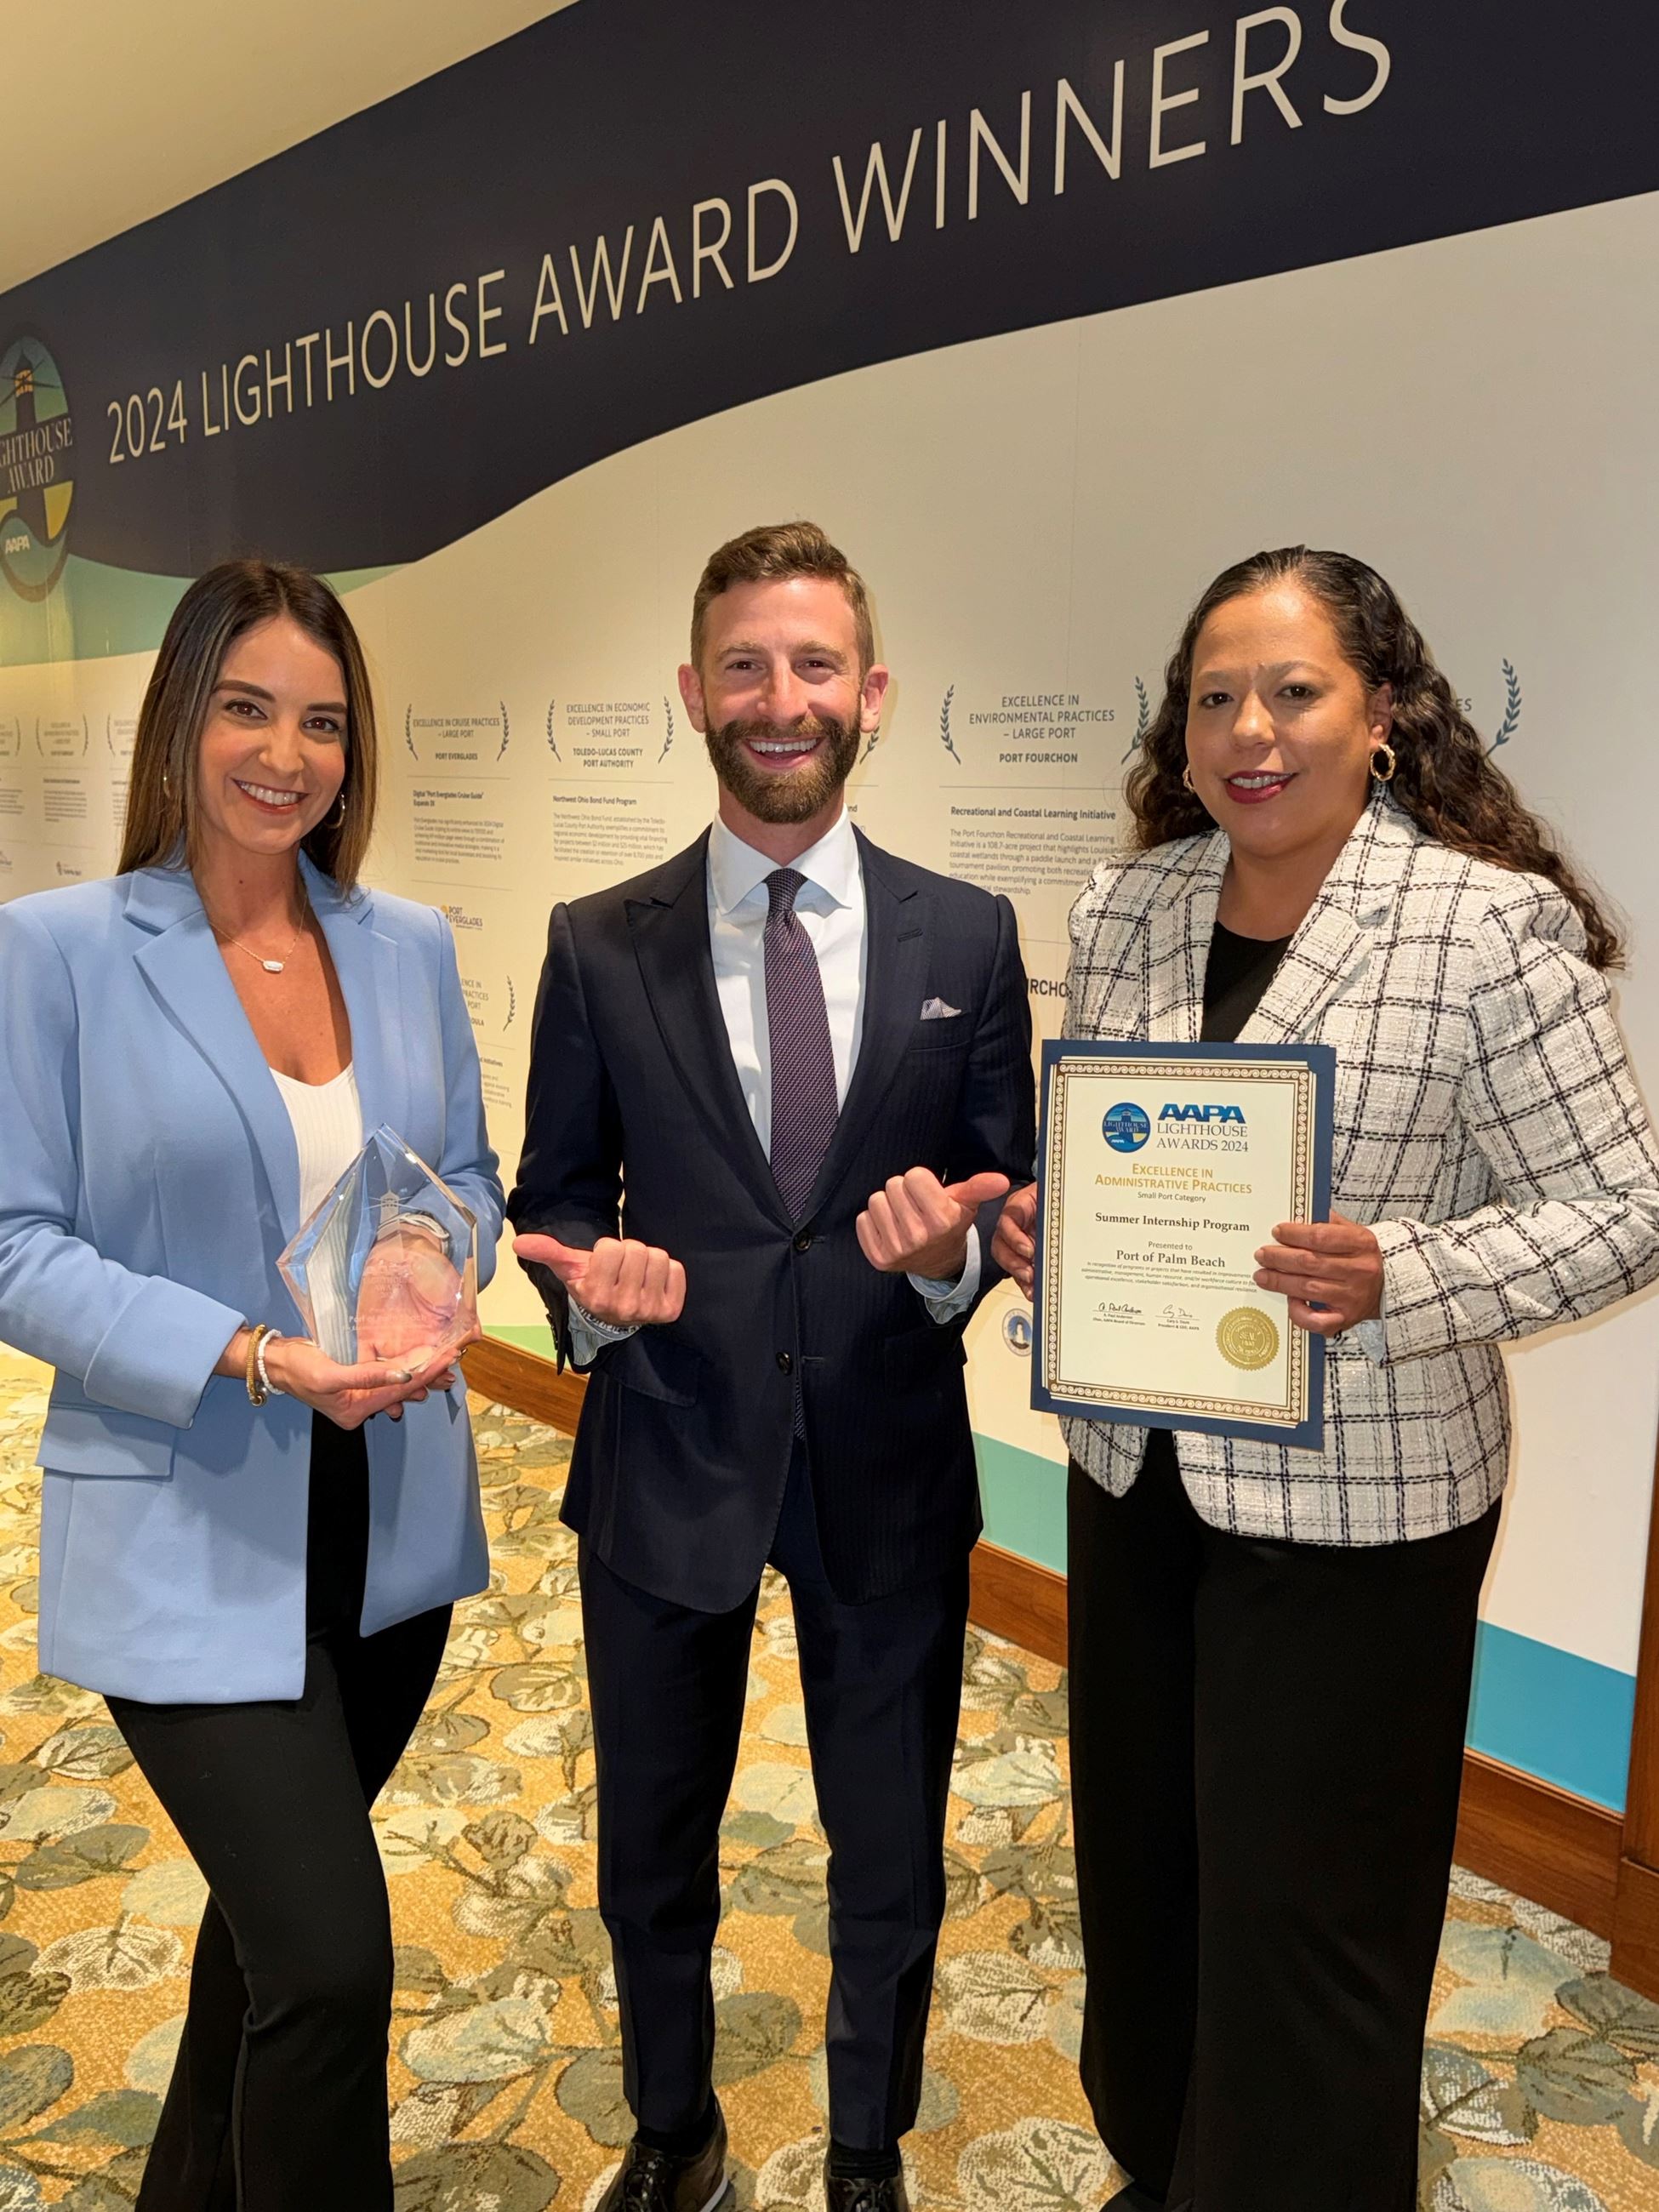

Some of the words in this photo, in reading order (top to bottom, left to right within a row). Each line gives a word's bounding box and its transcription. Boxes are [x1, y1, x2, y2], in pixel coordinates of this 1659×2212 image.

[107, 379, 188, 465] 2024
[202, 269, 507, 437] LIGHTHOUSE
[529, 178, 799, 344] AWARD
[832, 0, 1392, 254] WINNERS
[8, 454, 55, 494] AWARD
[4, 534, 31, 555] AAPA
[1001, 694, 1065, 708] EXCELLENCE
[1068, 693, 1080, 705] IN
[566, 703, 604, 713] EXCELLENCE
[605, 703, 613, 712] IN
[614, 702, 651, 712] ECONOMIC
[567, 715, 613, 726] DEVELOPMENT
[614, 715, 649, 725] PRACTICES
[969, 710, 1054, 724] ENVIRONMENTAL
[1058, 709, 1115, 722] PRACTICES
[460, 729, 474, 738] PORT
[592, 728, 612, 738] SMALL
[613, 728, 630, 738] PORT
[1012, 727, 1046, 739] LARGE
[1048, 727, 1076, 738] PORT
[435, 752, 448, 761] PORT
[448, 752, 478, 761] EVERGLADES
[573, 748, 617, 756] TOLEDO-LUCAS
[618, 748, 643, 756] COUNTY
[999, 753, 1023, 763] PORT
[1025, 753, 1078, 763] FOURCHON
[583, 759, 599, 768] PORT
[600, 759, 634, 769] AUTHORITY
[603, 796, 615, 805] Fund
[616, 797, 637, 807] Program
[950, 806, 996, 817] Recreational
[997, 808, 1012, 818] and
[1013, 807, 1042, 818] Coastal
[1044, 809, 1078, 821] Learning
[1080, 809, 1116, 819] Initiative
[950, 829, 961, 837] The
[962, 829, 975, 837] Port
[976, 830, 1005, 839] Fourchon
[1060, 833, 1085, 842] Coastal
[1086, 835, 1115, 845] Learning
[1046, 866, 1062, 875] both
[448, 905, 463, 916] PORT
[449, 914, 483, 927] EVERGLADES
[1157, 1103, 1246, 1124] AAPA
[1157, 1122, 1248, 1137] LIGHTHOUSE
[1156, 1137, 1218, 1151] AWARDS
[1221, 1140, 1249, 1152] 2024
[1132, 1163, 1199, 1178] EXCELLENCE
[1201, 1168, 1213, 1179] IN
[1094, 1173, 1189, 1190] ADMINISTRATIVE
[1192, 1179, 1252, 1194] PRACTICES
[1158, 1193, 1172, 1201] Port
[1174, 1194, 1206, 1204] Category
[1095, 1211, 1140, 1225] Summer
[1143, 1215, 1200, 1231] Internship
[1203, 1218, 1251, 1234] Program
[1148, 1240, 1183, 1251] Presented
[1184, 1243, 1194, 1251] to
[1115, 1249, 1139, 1262] Port
[1142, 1251, 1156, 1263] of
[1158, 1252, 1188, 1265] Palm
[1190, 1255, 1226, 1268] Beach
